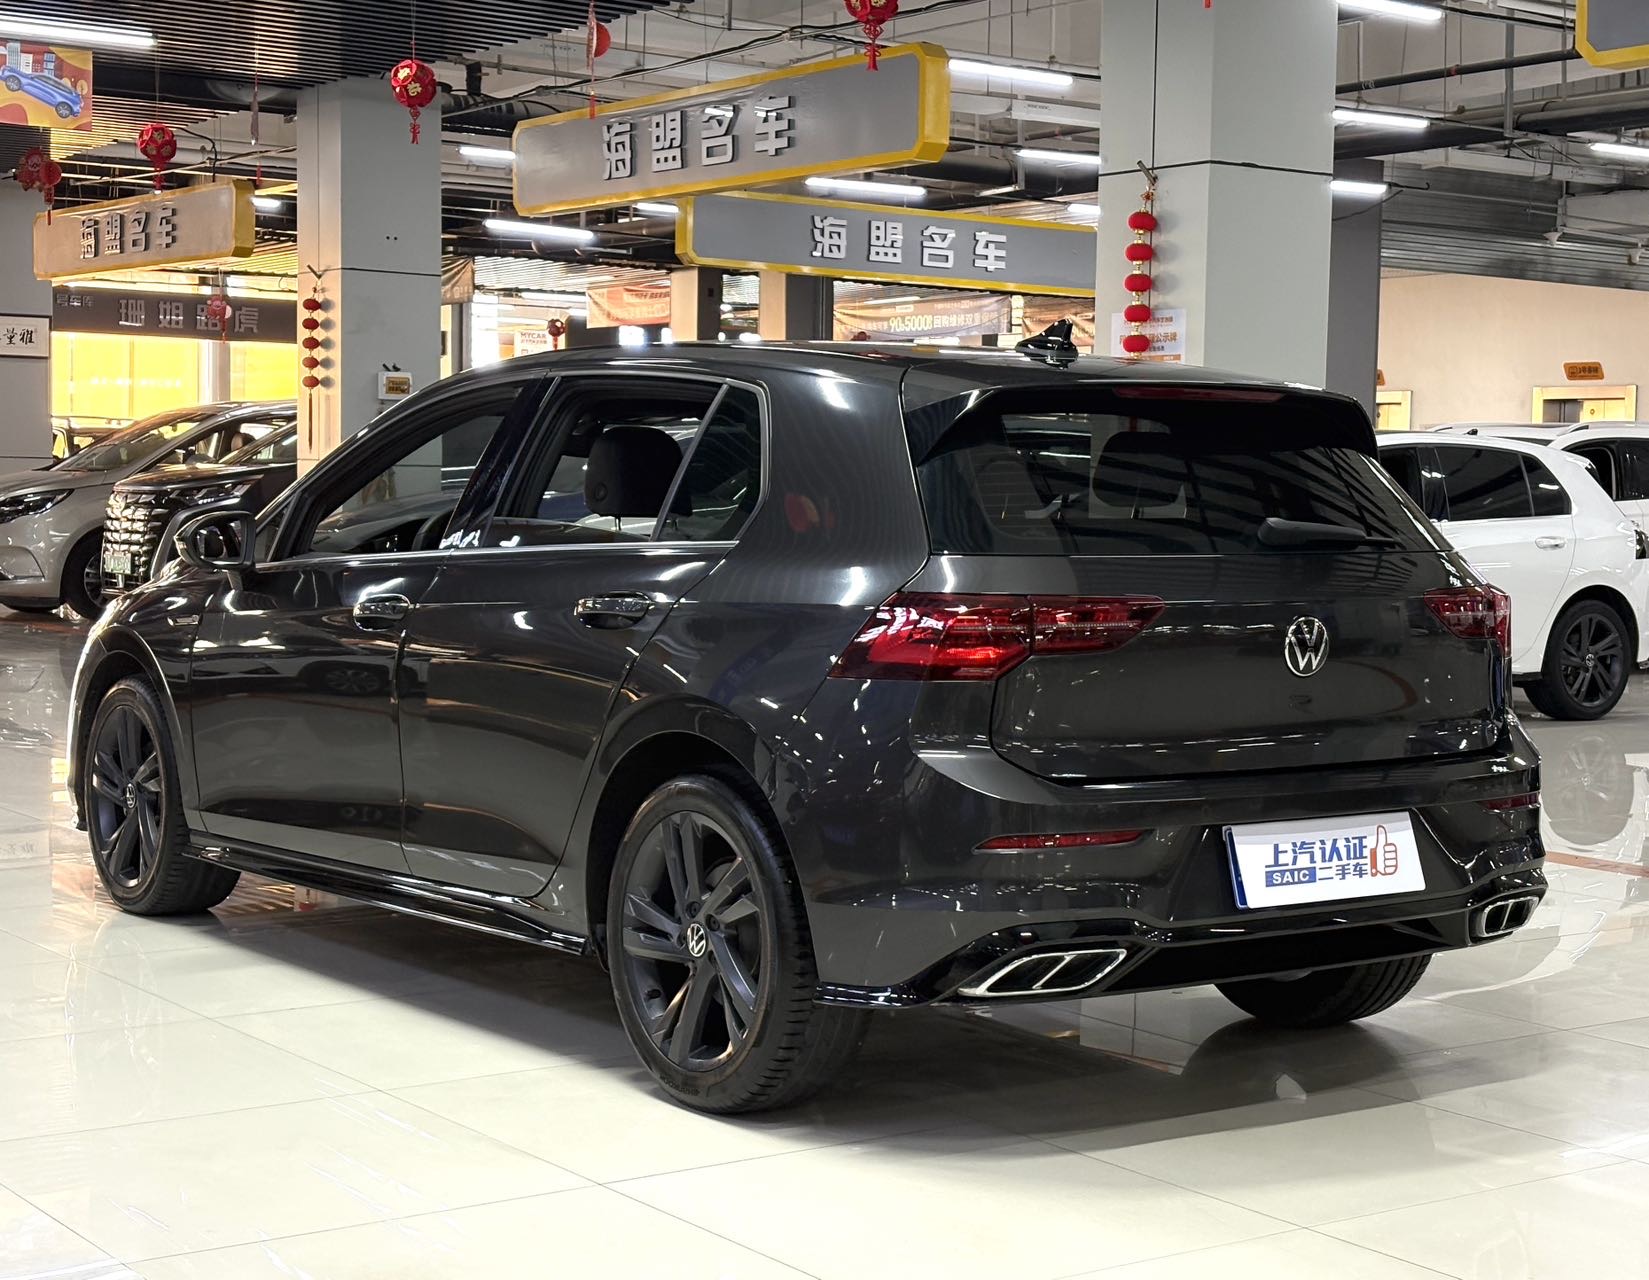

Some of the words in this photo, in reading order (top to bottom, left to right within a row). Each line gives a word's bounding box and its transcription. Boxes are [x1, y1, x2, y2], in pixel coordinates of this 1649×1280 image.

[601, 95, 793, 180] 海盟名车
[80, 206, 176, 260] 海盟名车
[811, 215, 1007, 272] 海盟名车
[520, 331, 547, 339] MYCAR
[1265, 835, 1368, 868] 上汽认证
[1272, 870, 1310, 884] SAIC
[1318, 862, 1368, 881] 二手车
